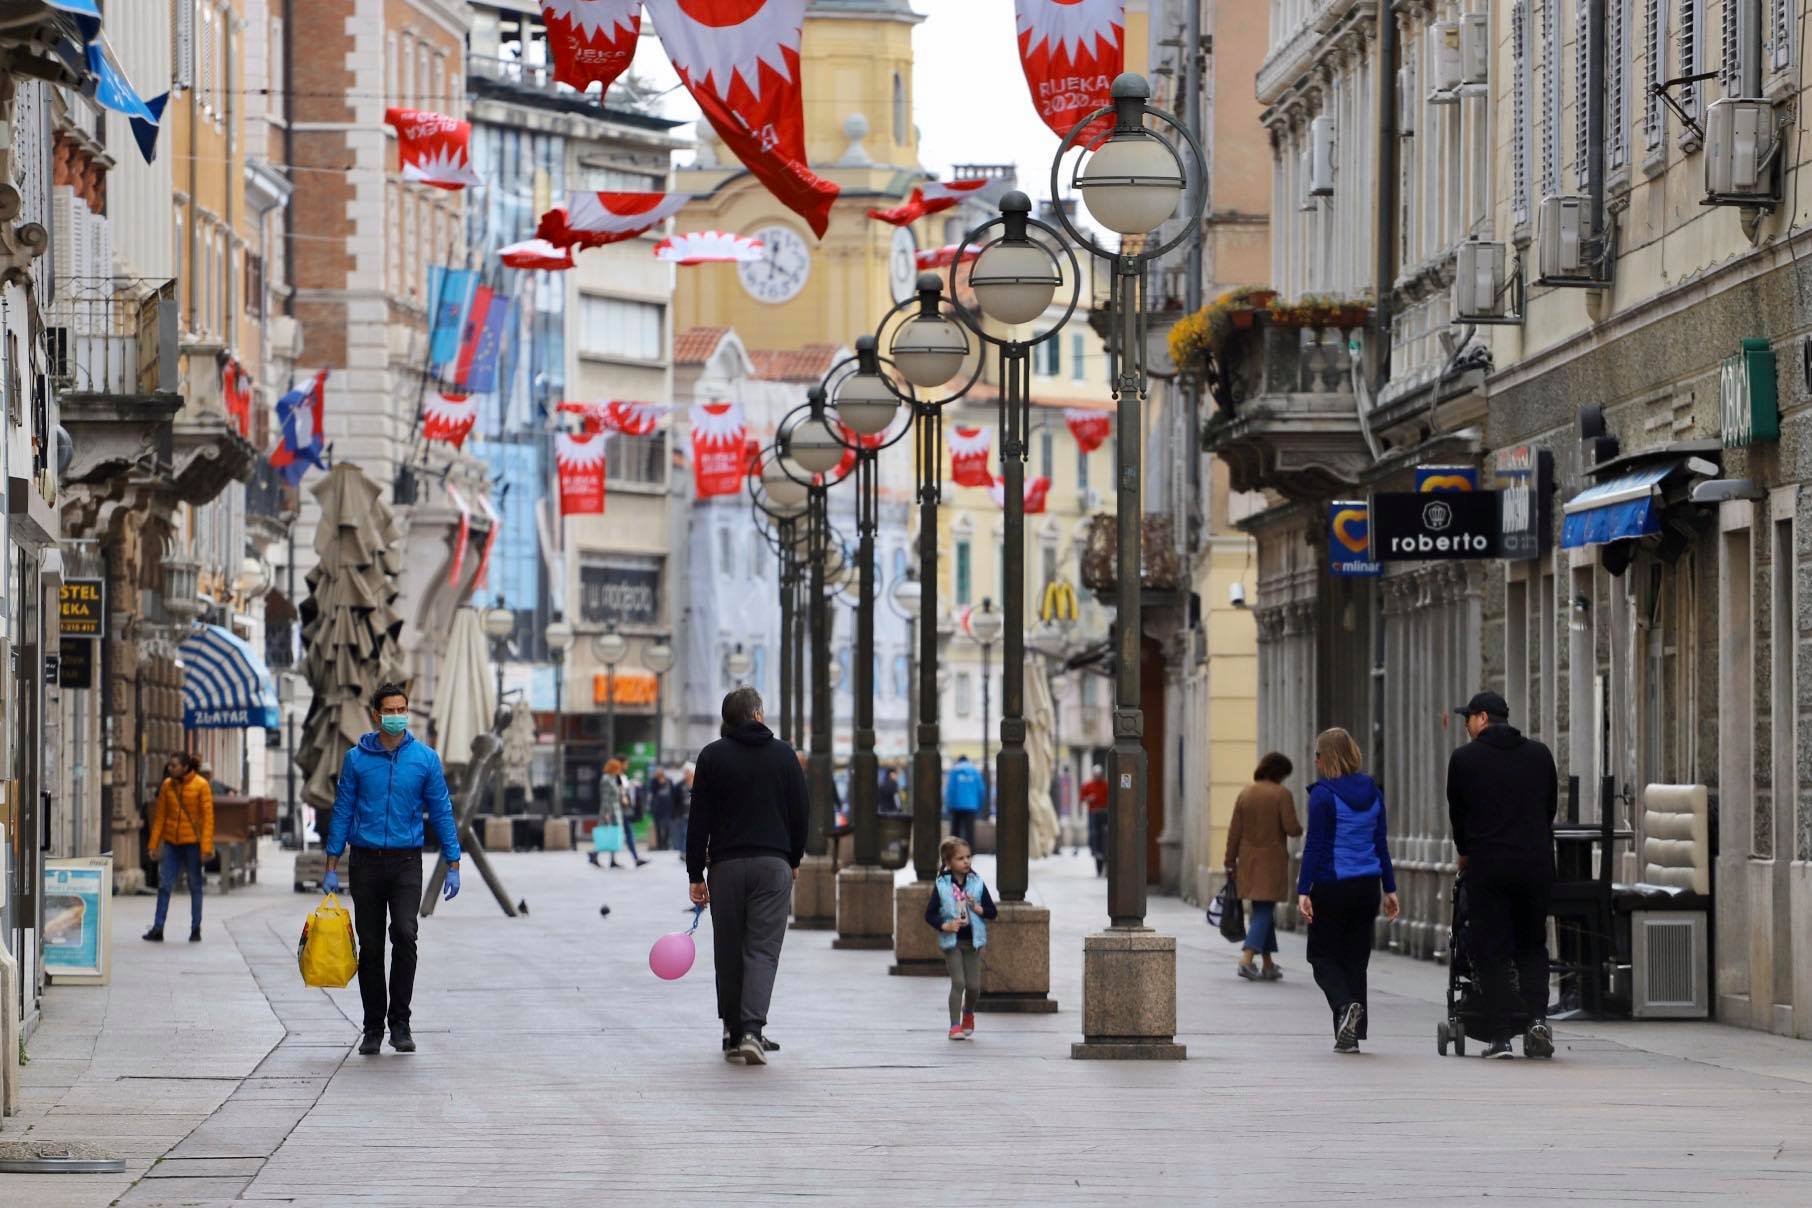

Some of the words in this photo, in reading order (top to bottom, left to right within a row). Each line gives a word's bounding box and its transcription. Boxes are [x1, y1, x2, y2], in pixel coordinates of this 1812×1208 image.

[1039, 75, 1110, 97] RIJEKA
[1391, 531, 1488, 551] roberto
[1342, 560, 1380, 573] mlinar
[58, 584, 99, 600] STEL
[58, 603, 89, 615] EKA
[195, 710, 249, 724] ZLATAR
